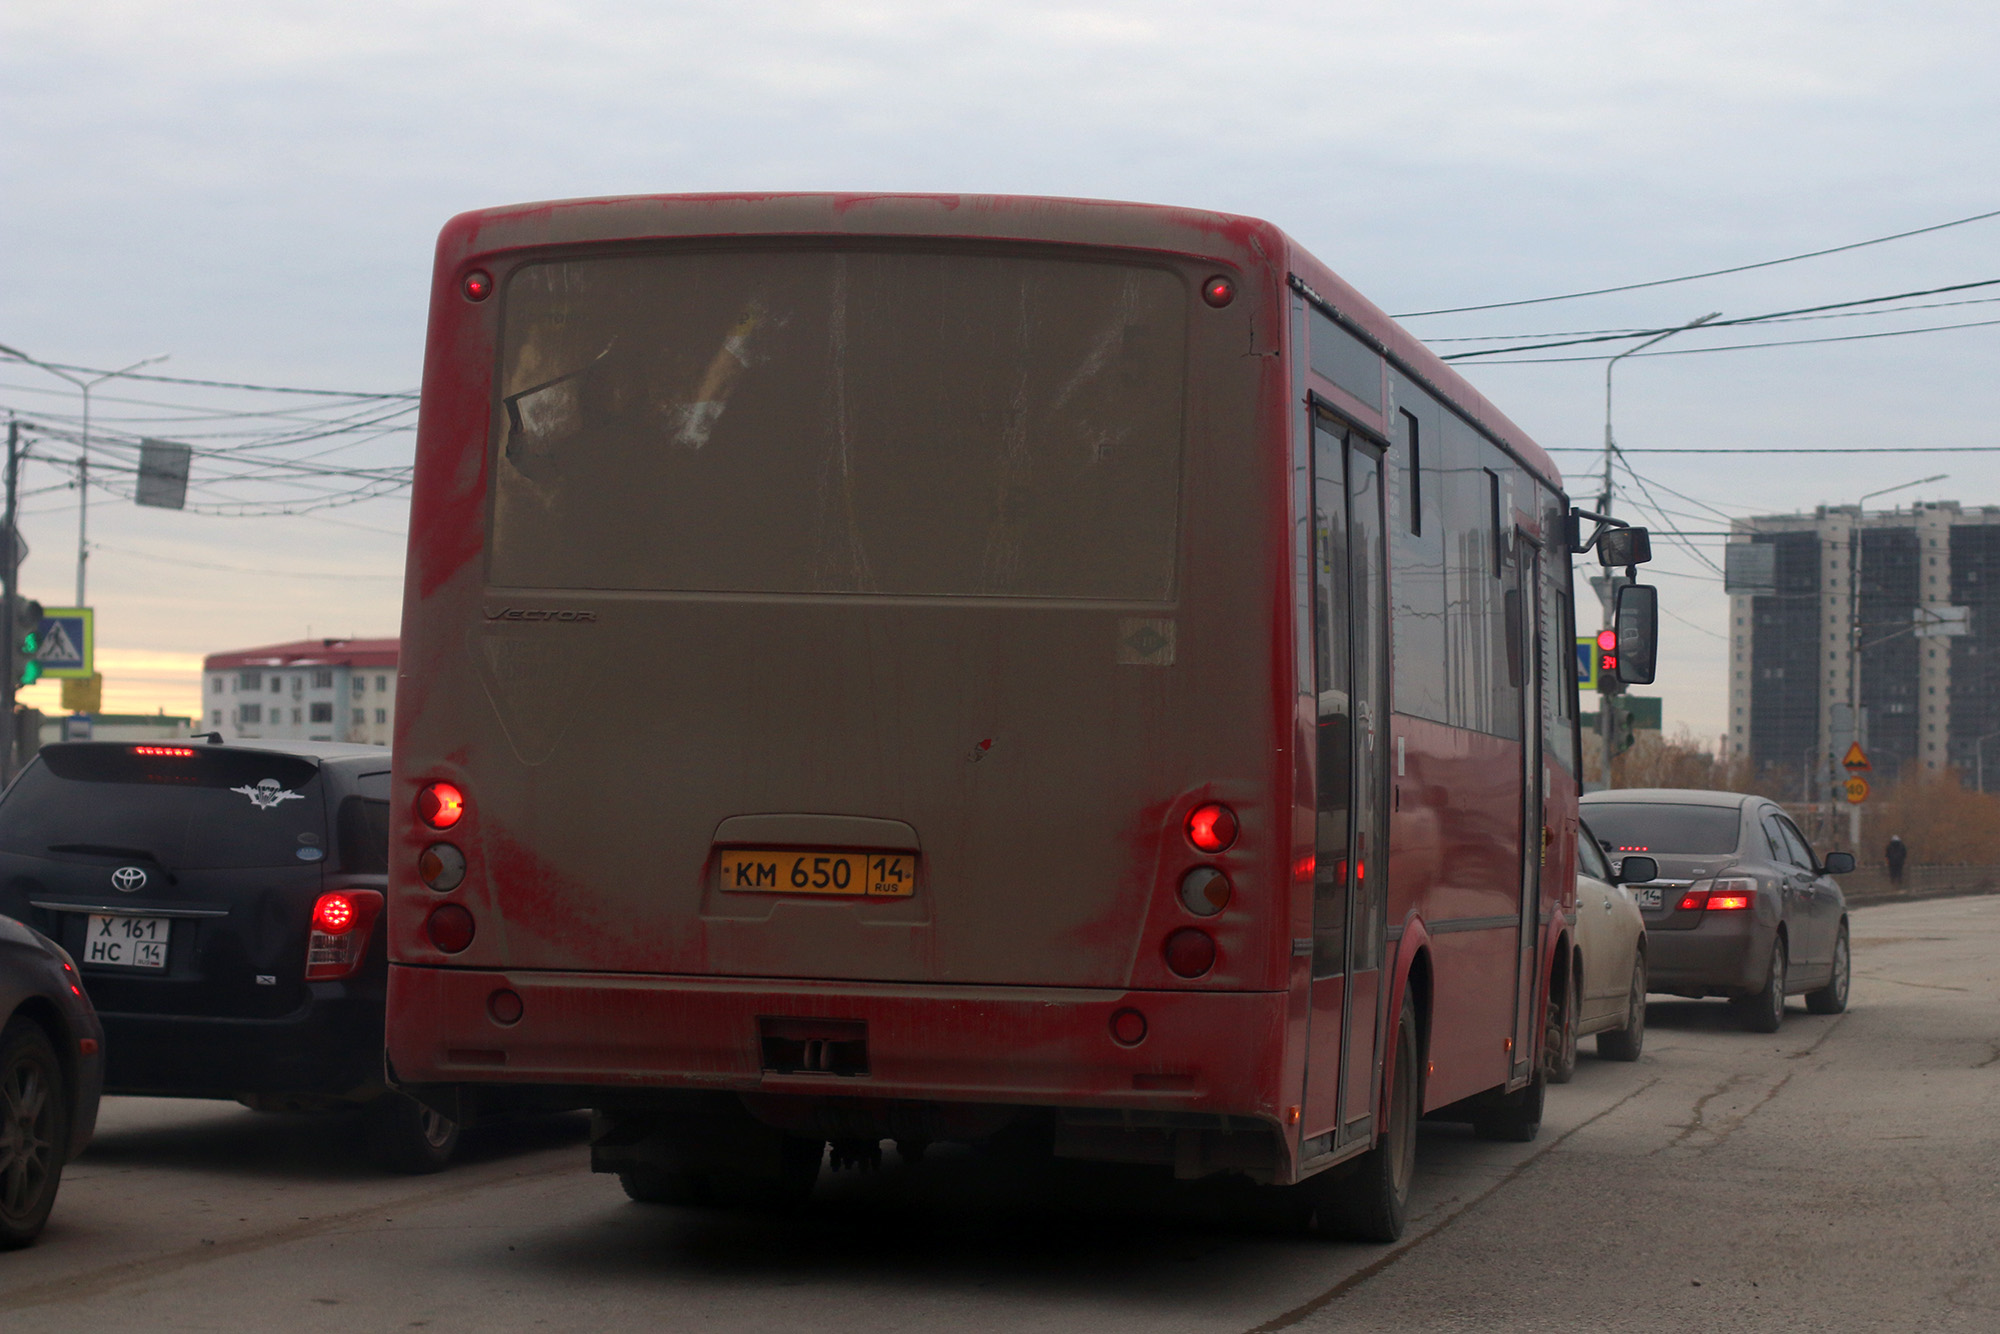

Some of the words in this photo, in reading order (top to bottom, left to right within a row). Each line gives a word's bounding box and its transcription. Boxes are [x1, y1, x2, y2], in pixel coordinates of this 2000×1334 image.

[790, 857, 851, 889] 650
[873, 858, 903, 883] 14
[875, 882, 898, 893] RUS
[1643, 890, 1657, 901] 14
[122, 919, 156, 939] 161
[142, 944, 160, 960] 14
